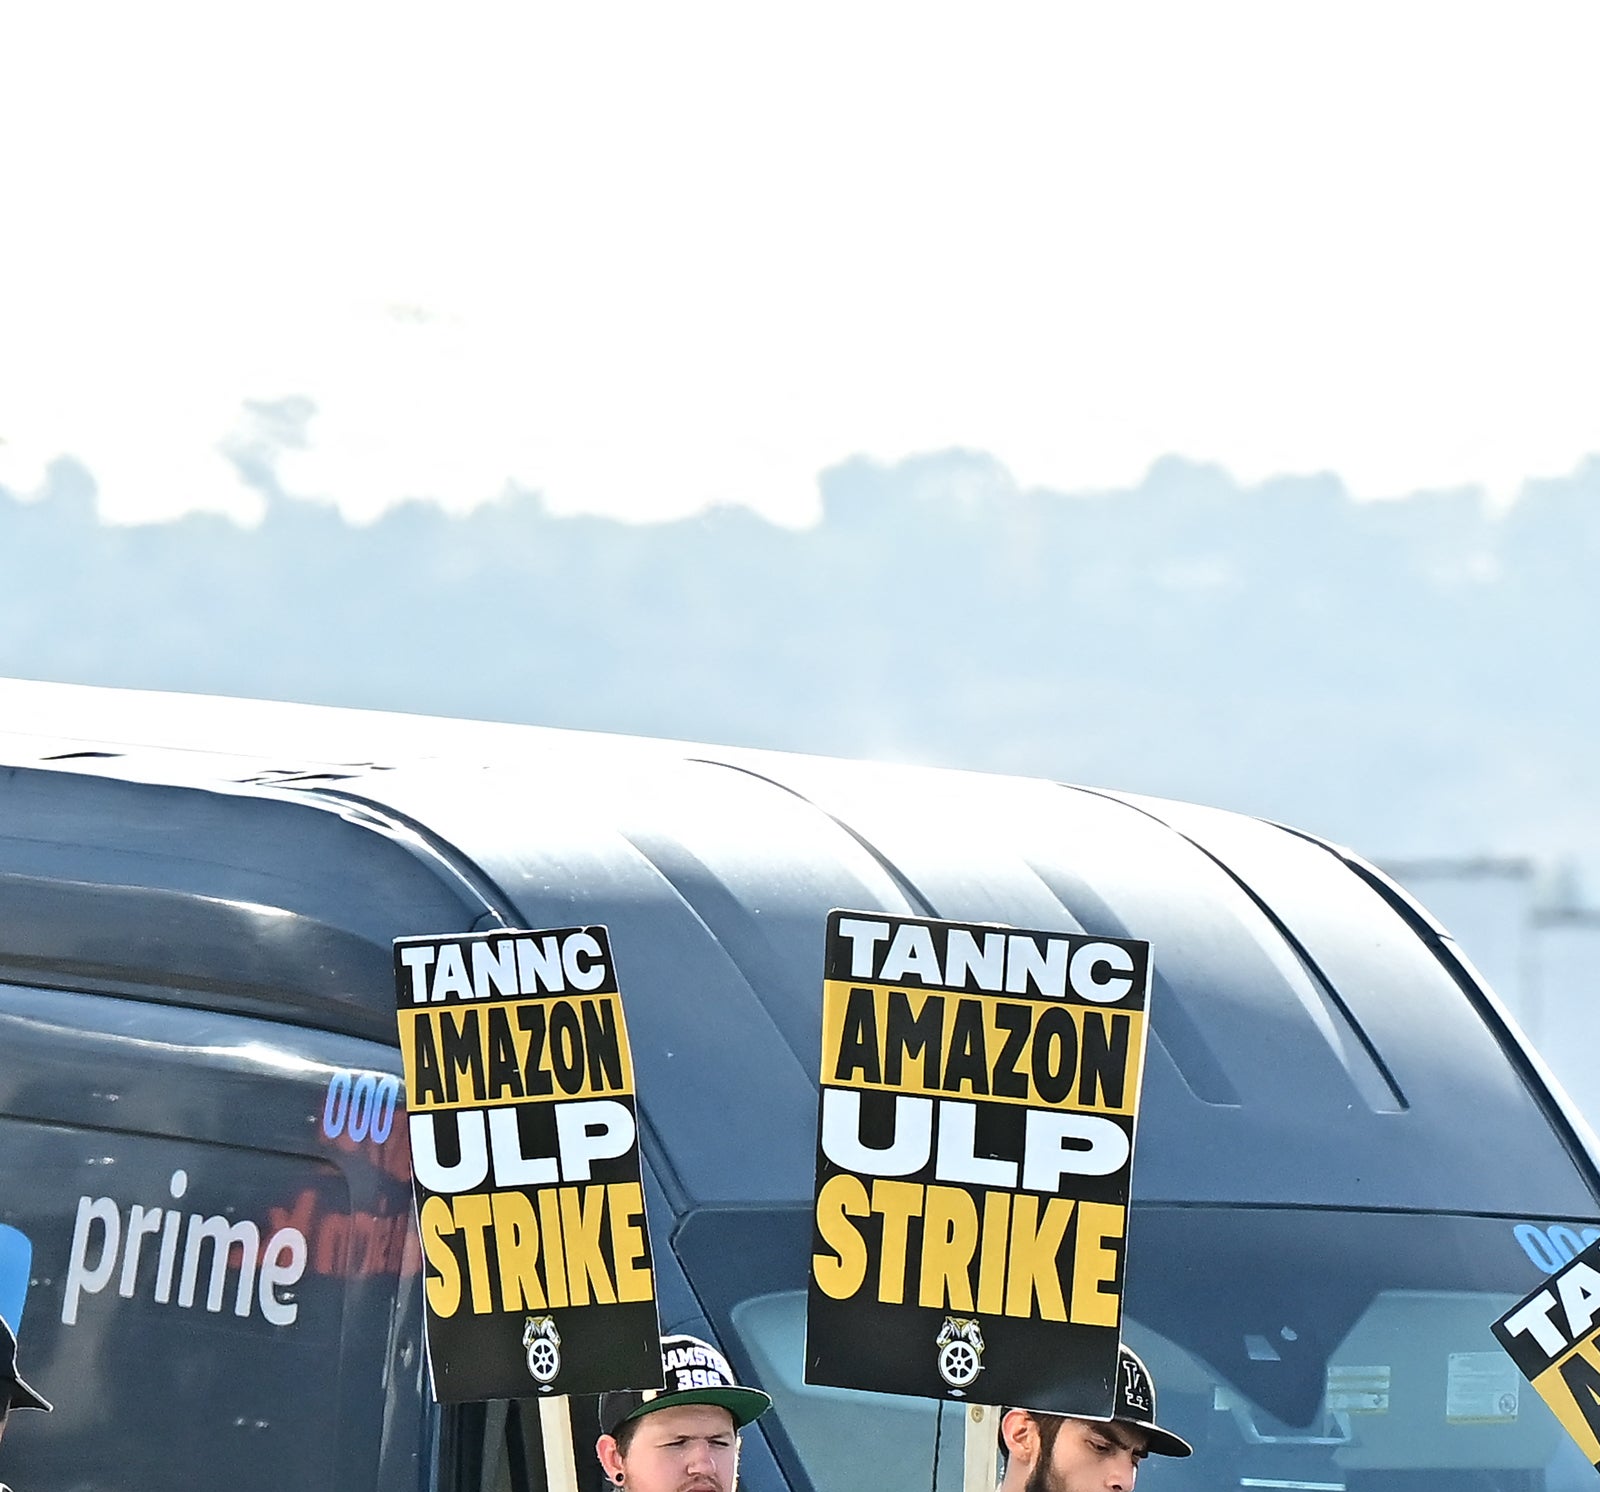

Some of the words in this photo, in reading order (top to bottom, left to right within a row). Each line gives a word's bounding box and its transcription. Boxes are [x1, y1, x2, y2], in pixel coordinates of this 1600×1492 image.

[399, 943, 605, 1003] TANNC
[838, 918, 1134, 1003] TANNC
[413, 998, 625, 1107] AMAZON
[835, 987, 1129, 1108] AMAZON
[410, 1101, 635, 1193] ULP
[820, 1088, 1130, 1193] ULP
[61, 1170, 308, 1326] prime
[425, 1180, 654, 1319] STRIKE
[812, 1173, 1126, 1328] STRIKE
[676, 1368, 721, 1390] 396
